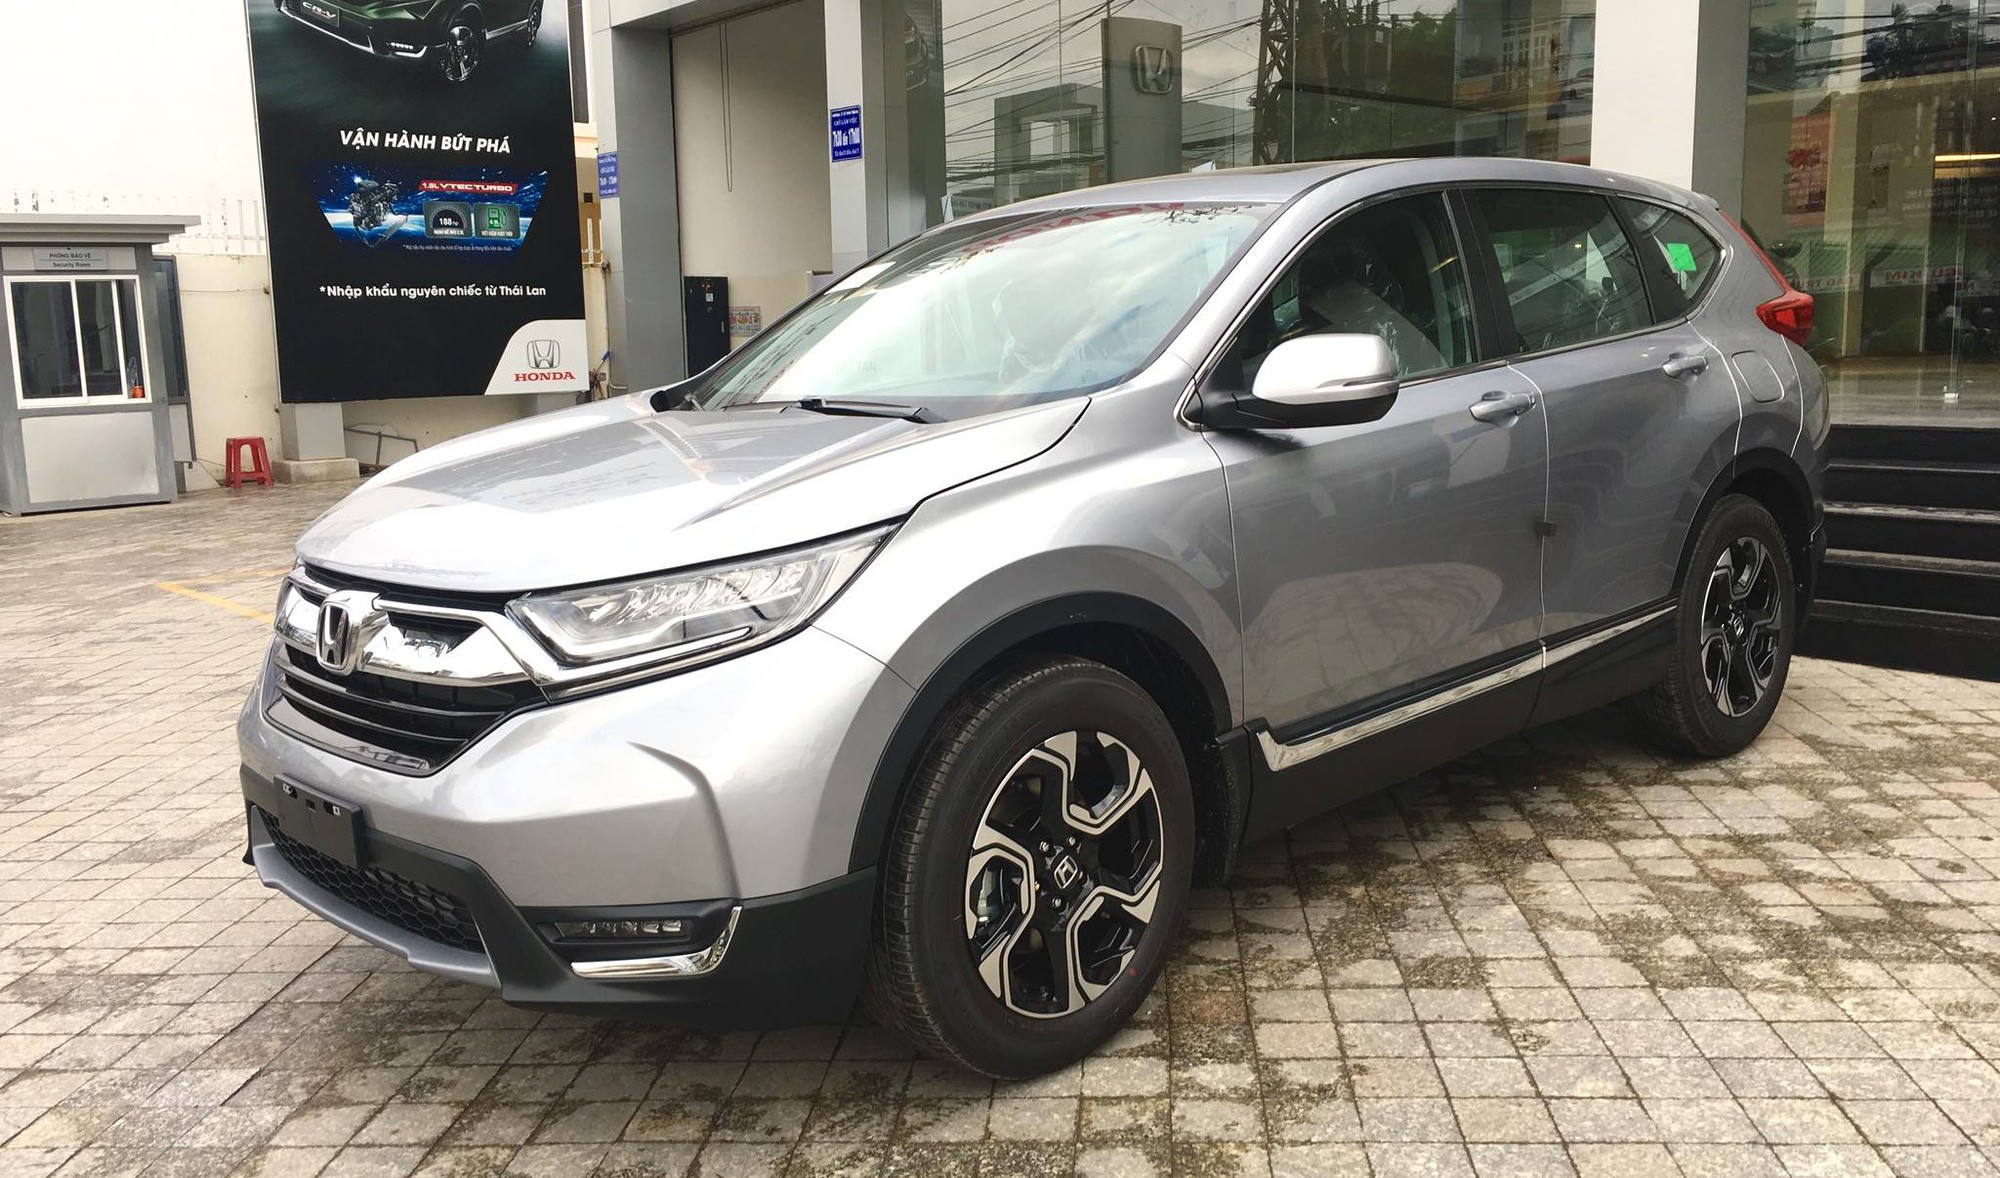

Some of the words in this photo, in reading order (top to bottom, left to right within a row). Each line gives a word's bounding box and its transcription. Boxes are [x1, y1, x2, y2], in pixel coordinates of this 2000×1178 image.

[340, 127, 379, 150] VẬN
[384, 129, 436, 150] HÀNH
[441, 132, 473, 151] BỨT
[476, 135, 511, 153] PHÁ
[439, 217, 452, 226] 188
[366, 283, 397, 297] khẩu
[401, 285, 446, 299] nguyên
[449, 283, 482, 296] chiếc
[485, 286, 497, 296] từ
[499, 285, 523, 296] Thái
[526, 285, 546, 296] Lan
[514, 371, 576, 382] HONDA
